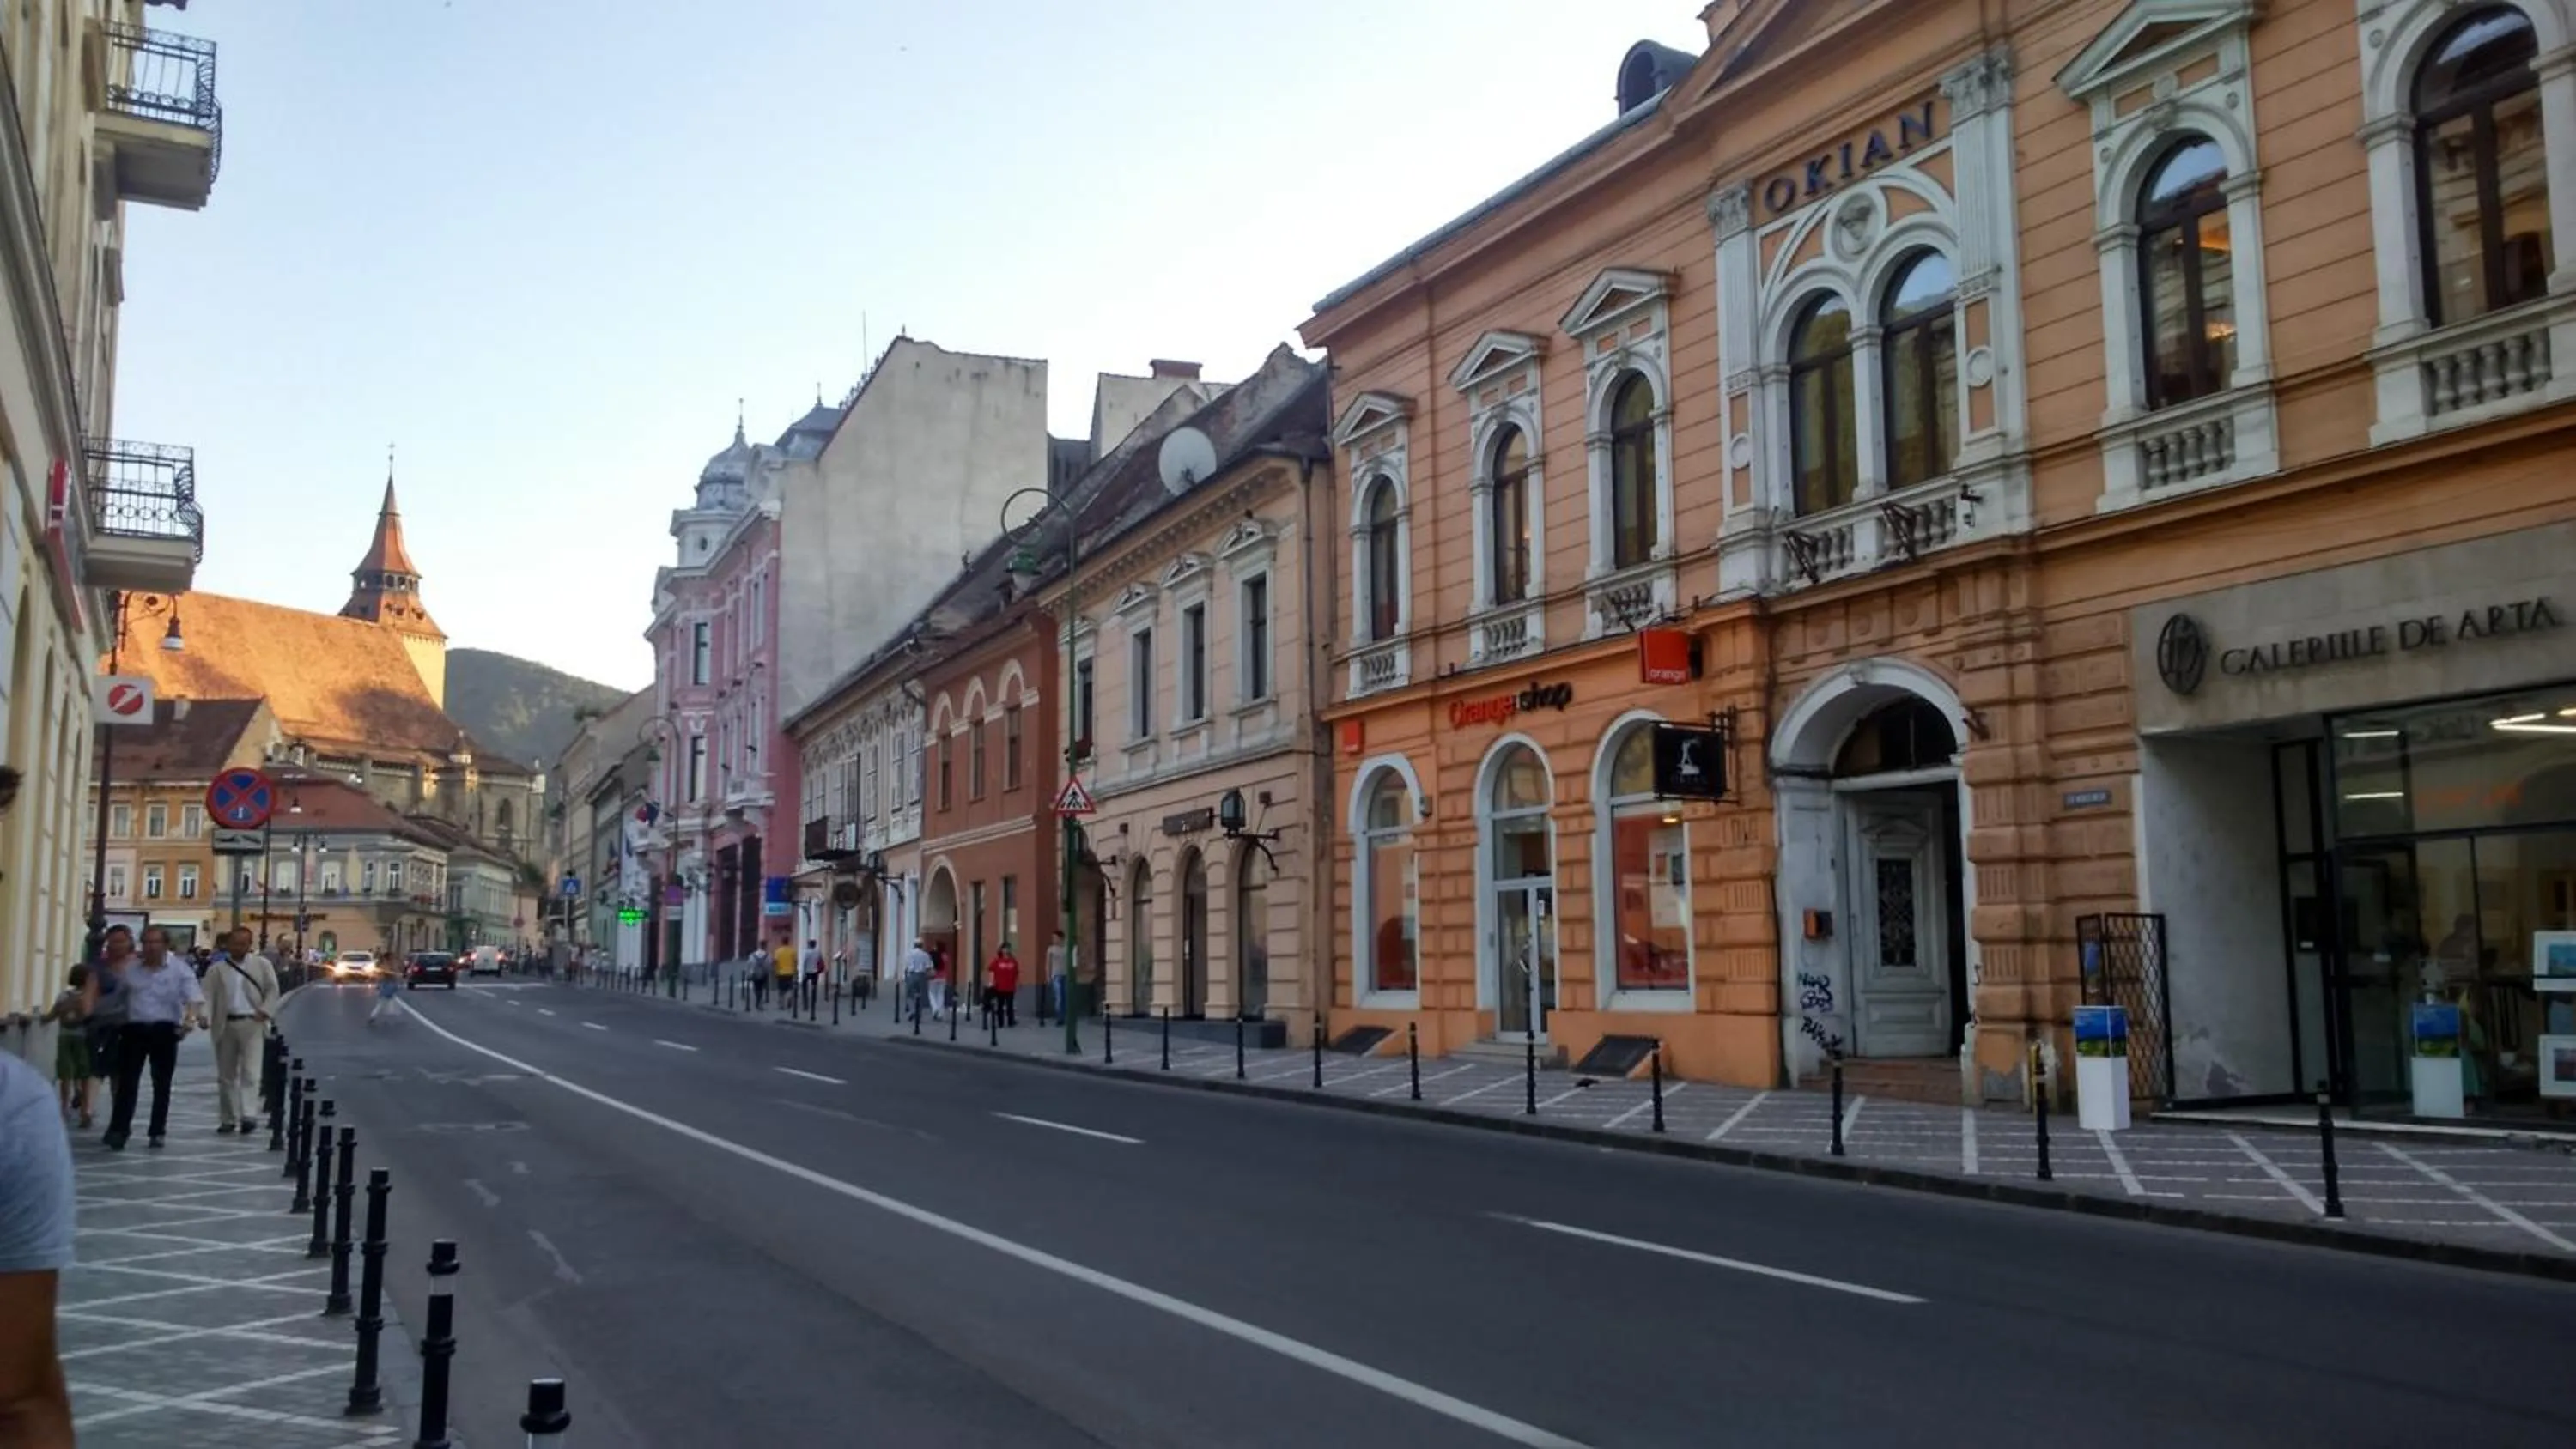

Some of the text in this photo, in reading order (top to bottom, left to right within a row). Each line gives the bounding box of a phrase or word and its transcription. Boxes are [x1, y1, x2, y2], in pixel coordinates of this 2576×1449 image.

[1764, 100, 1935, 213] OKIAN
[2398, 615, 2446, 651] DE
[1449, 696, 1513, 730] Orange
